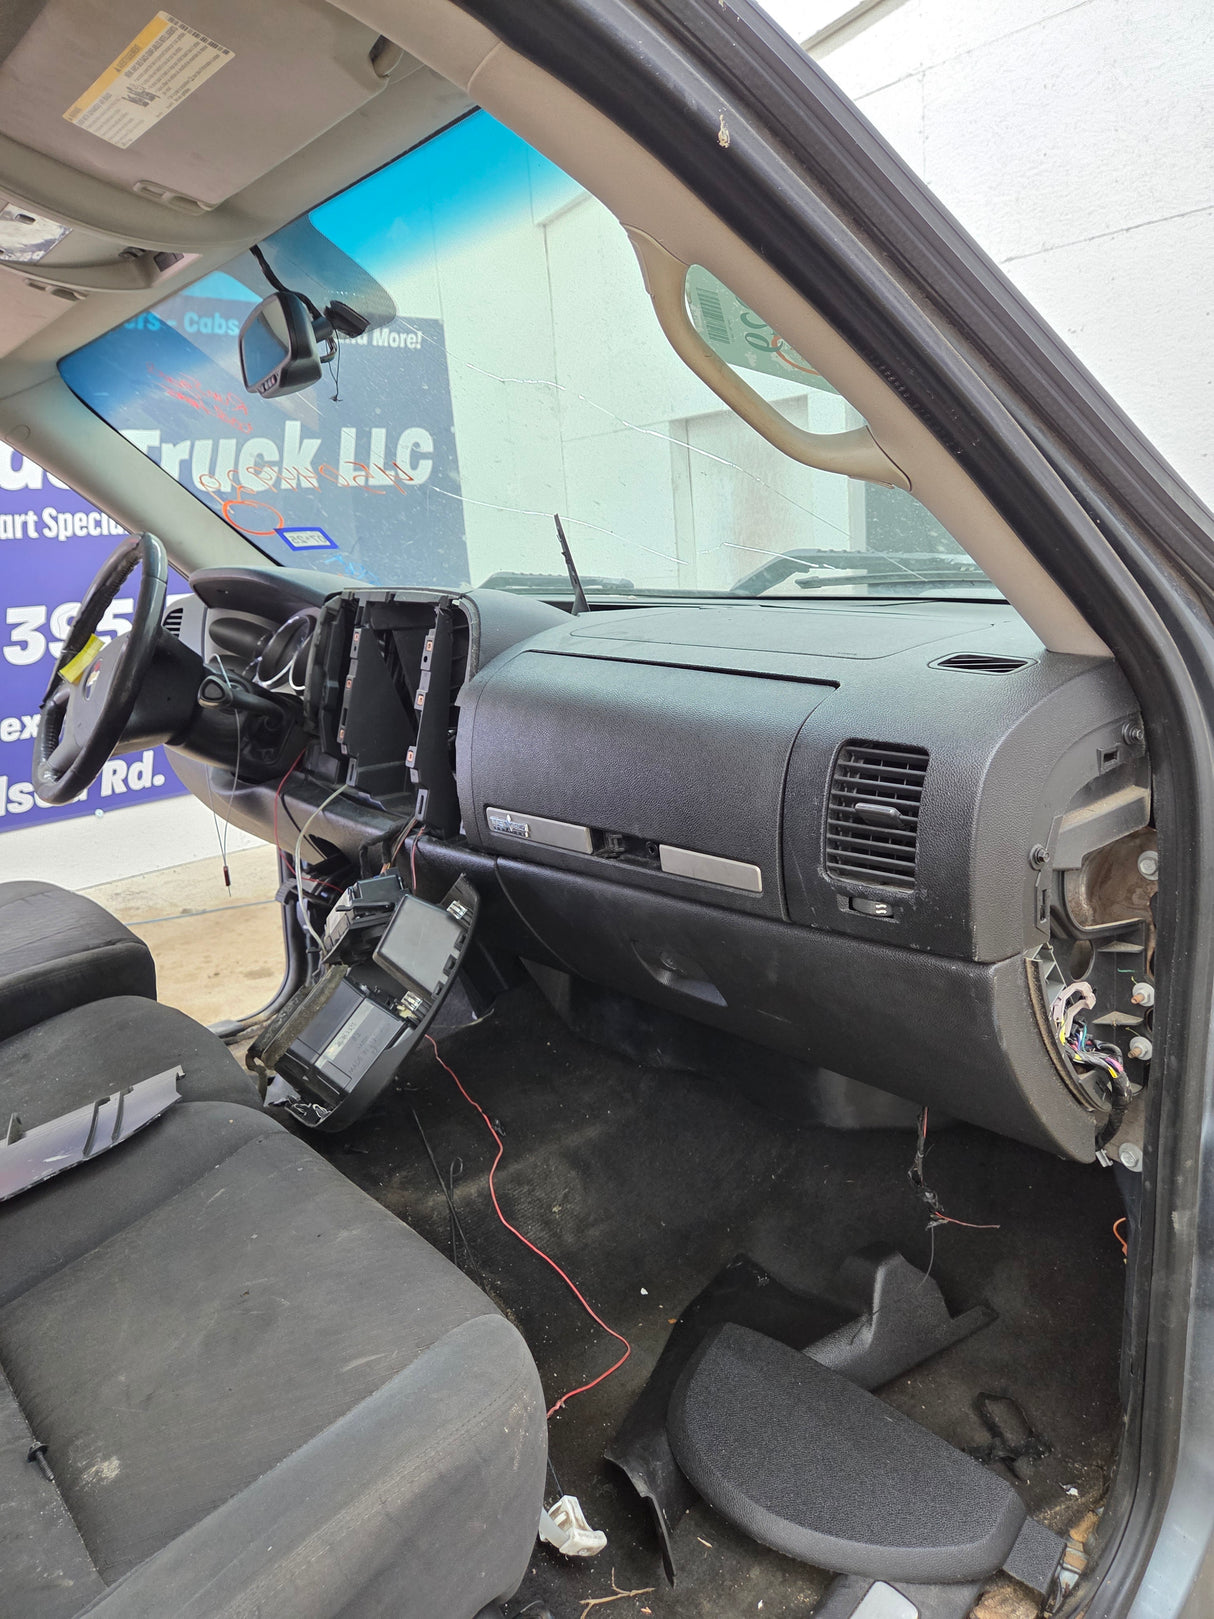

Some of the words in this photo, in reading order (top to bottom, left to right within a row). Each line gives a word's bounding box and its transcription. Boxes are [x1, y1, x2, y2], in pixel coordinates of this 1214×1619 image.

[183, 311, 239, 336] Cabs
[372, 327, 423, 350] More!
[119, 420, 321, 493] Truck
[338, 427, 434, 487] LLC
[101, 750, 165, 797] Rd.
